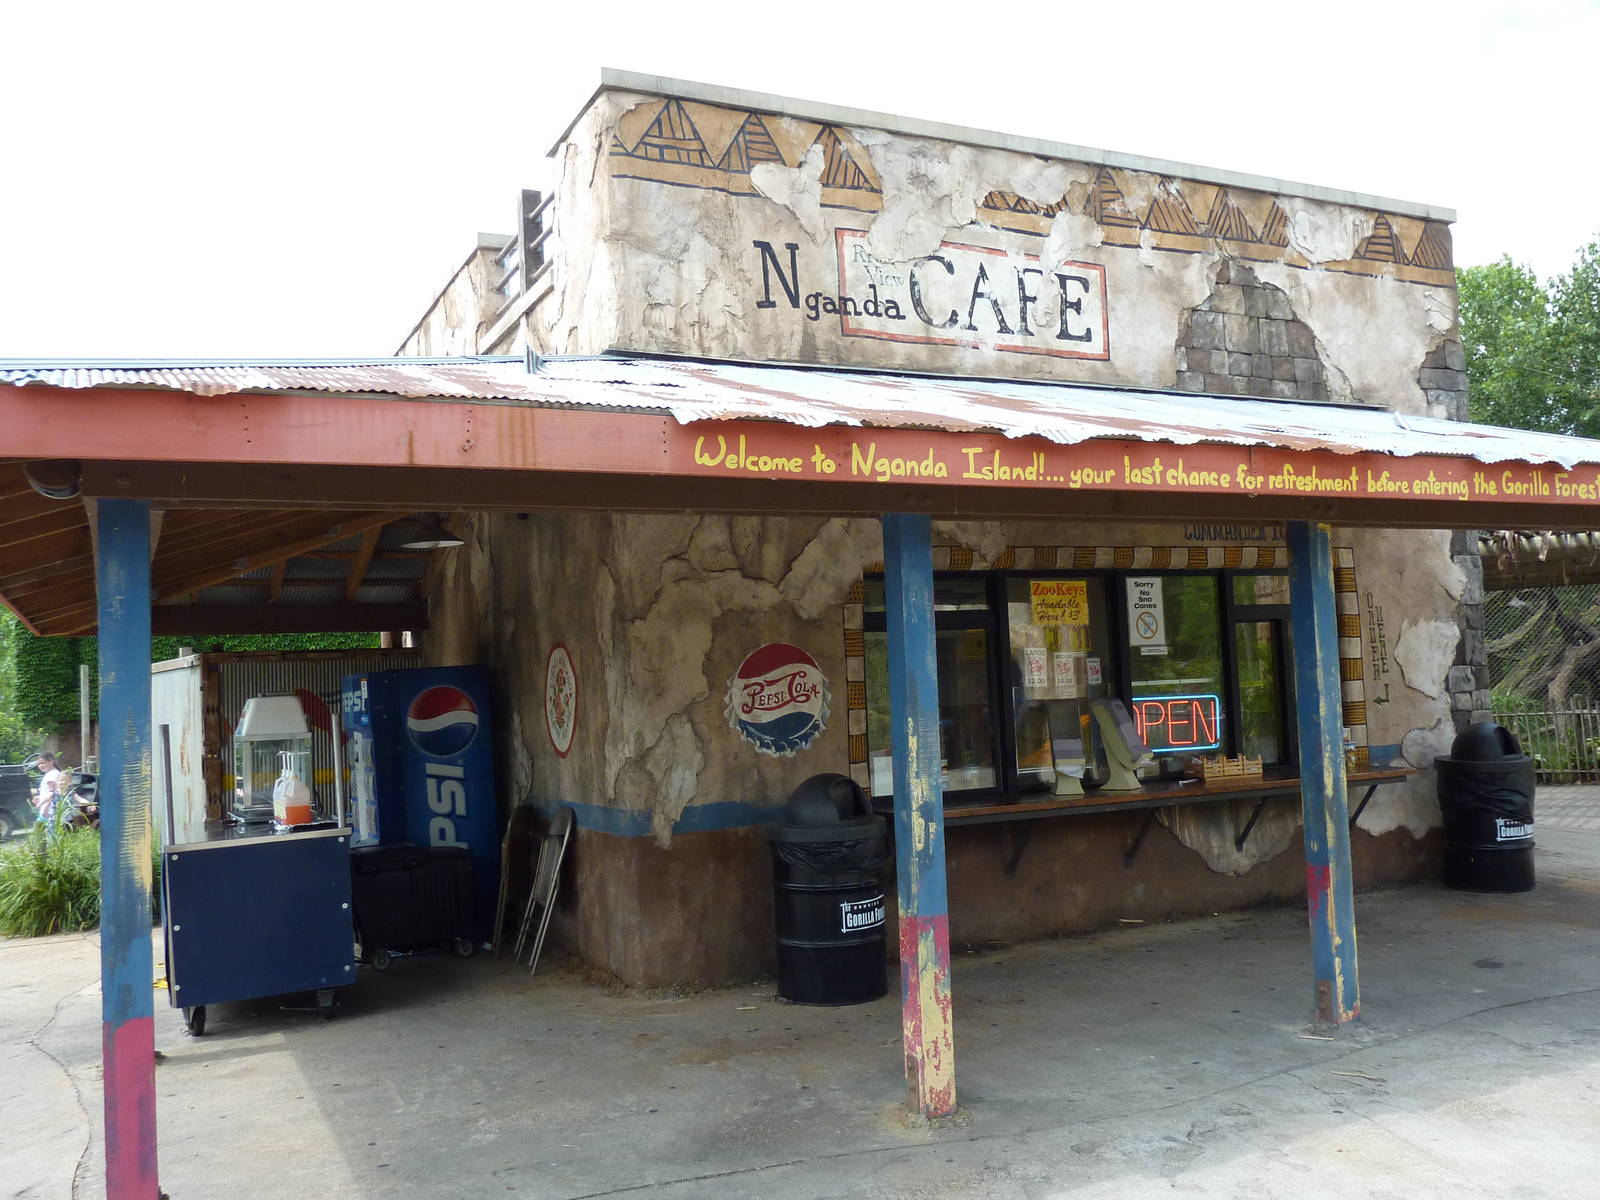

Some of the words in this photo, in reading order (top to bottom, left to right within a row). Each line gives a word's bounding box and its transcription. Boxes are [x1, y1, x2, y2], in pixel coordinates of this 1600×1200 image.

[753, 239, 906, 321] Nganda
[909, 255, 1093, 343] CAFE
[694, 434, 803, 473] Welcome
[811, 443, 836, 474] to
[851, 442, 948, 482] Nganda
[1069, 467, 1116, 489] your
[1123, 455, 1164, 485] last
[1166, 458, 1231, 488] chance
[1236, 463, 1264, 489] for
[1268, 463, 1359, 492] refreshment
[1367, 469, 1409, 493] before
[1412, 469, 1469, 501] entering
[1473, 471, 1498, 496] the
[1502, 470, 1550, 497] Gorilla
[425, 763, 469, 850] PSI
